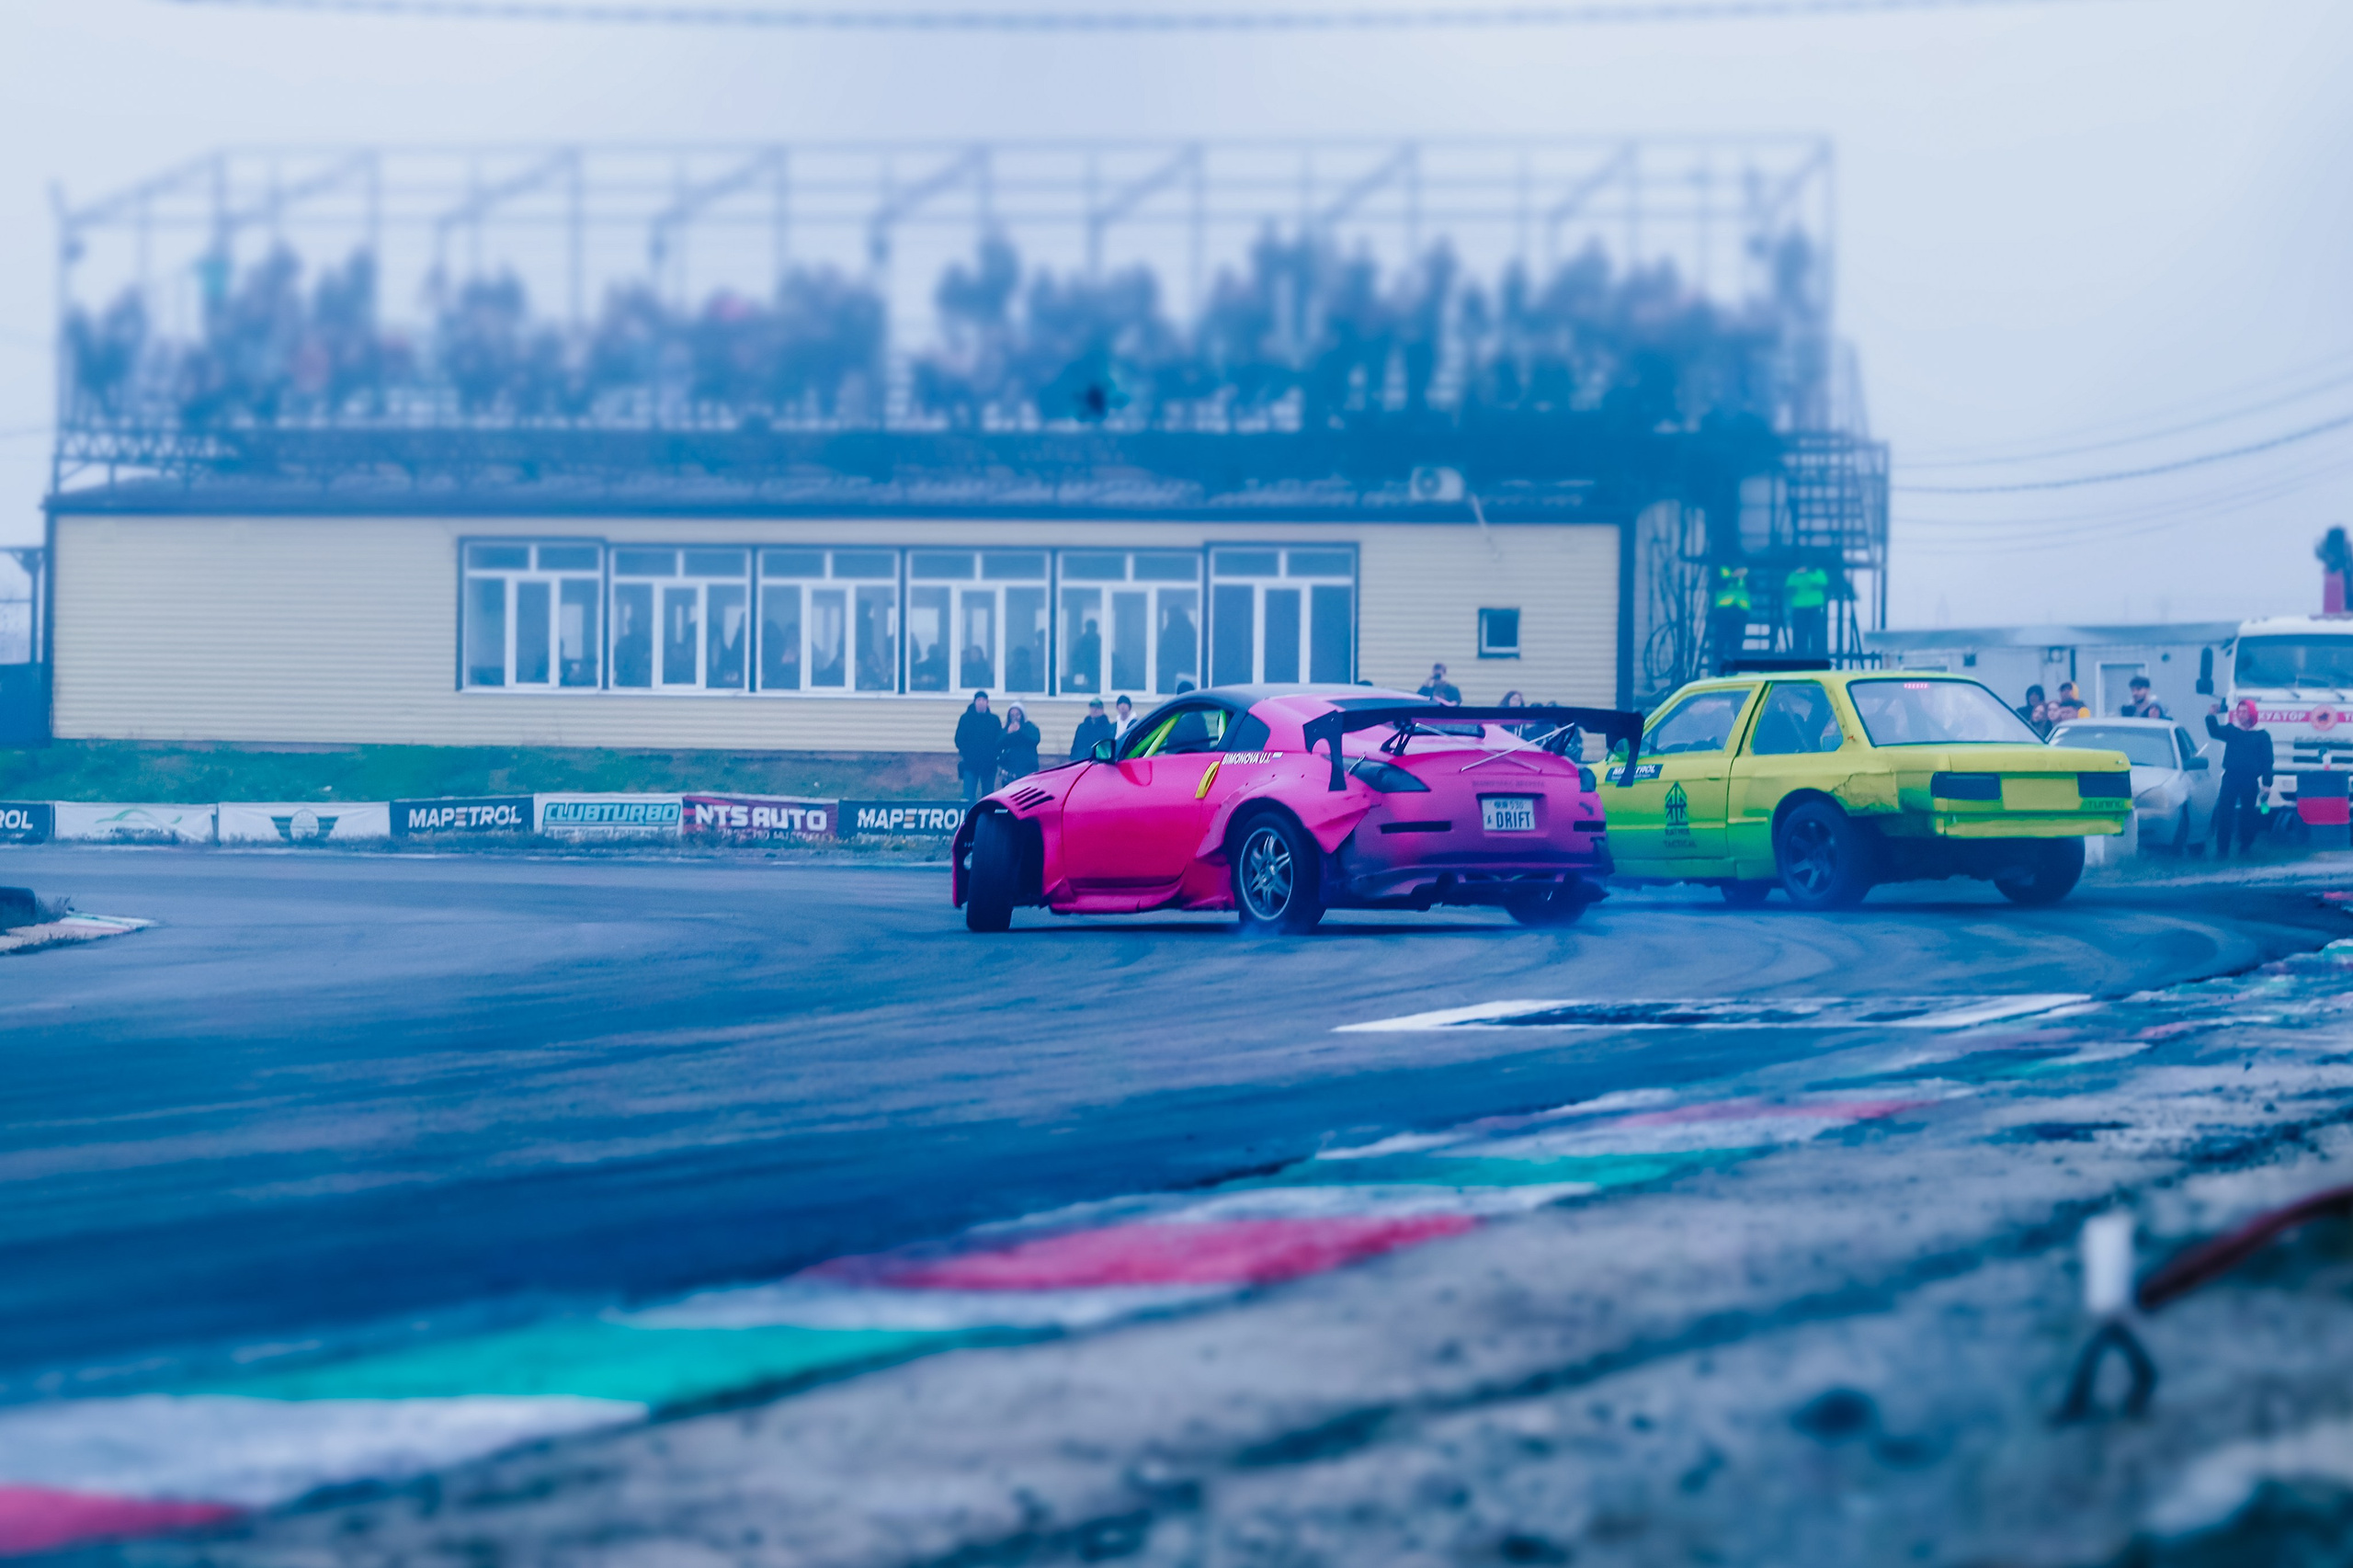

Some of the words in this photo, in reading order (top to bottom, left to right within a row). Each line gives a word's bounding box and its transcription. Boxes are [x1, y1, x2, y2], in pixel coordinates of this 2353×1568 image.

[1612, 765, 1655, 775] MATROL
[408, 805, 522, 828] MAPETROL
[544, 802, 680, 825] CLUBTURBO
[695, 804, 748, 827] NTS
[752, 806, 827, 832] AUTO
[1495, 811, 1530, 828] DRIFT
